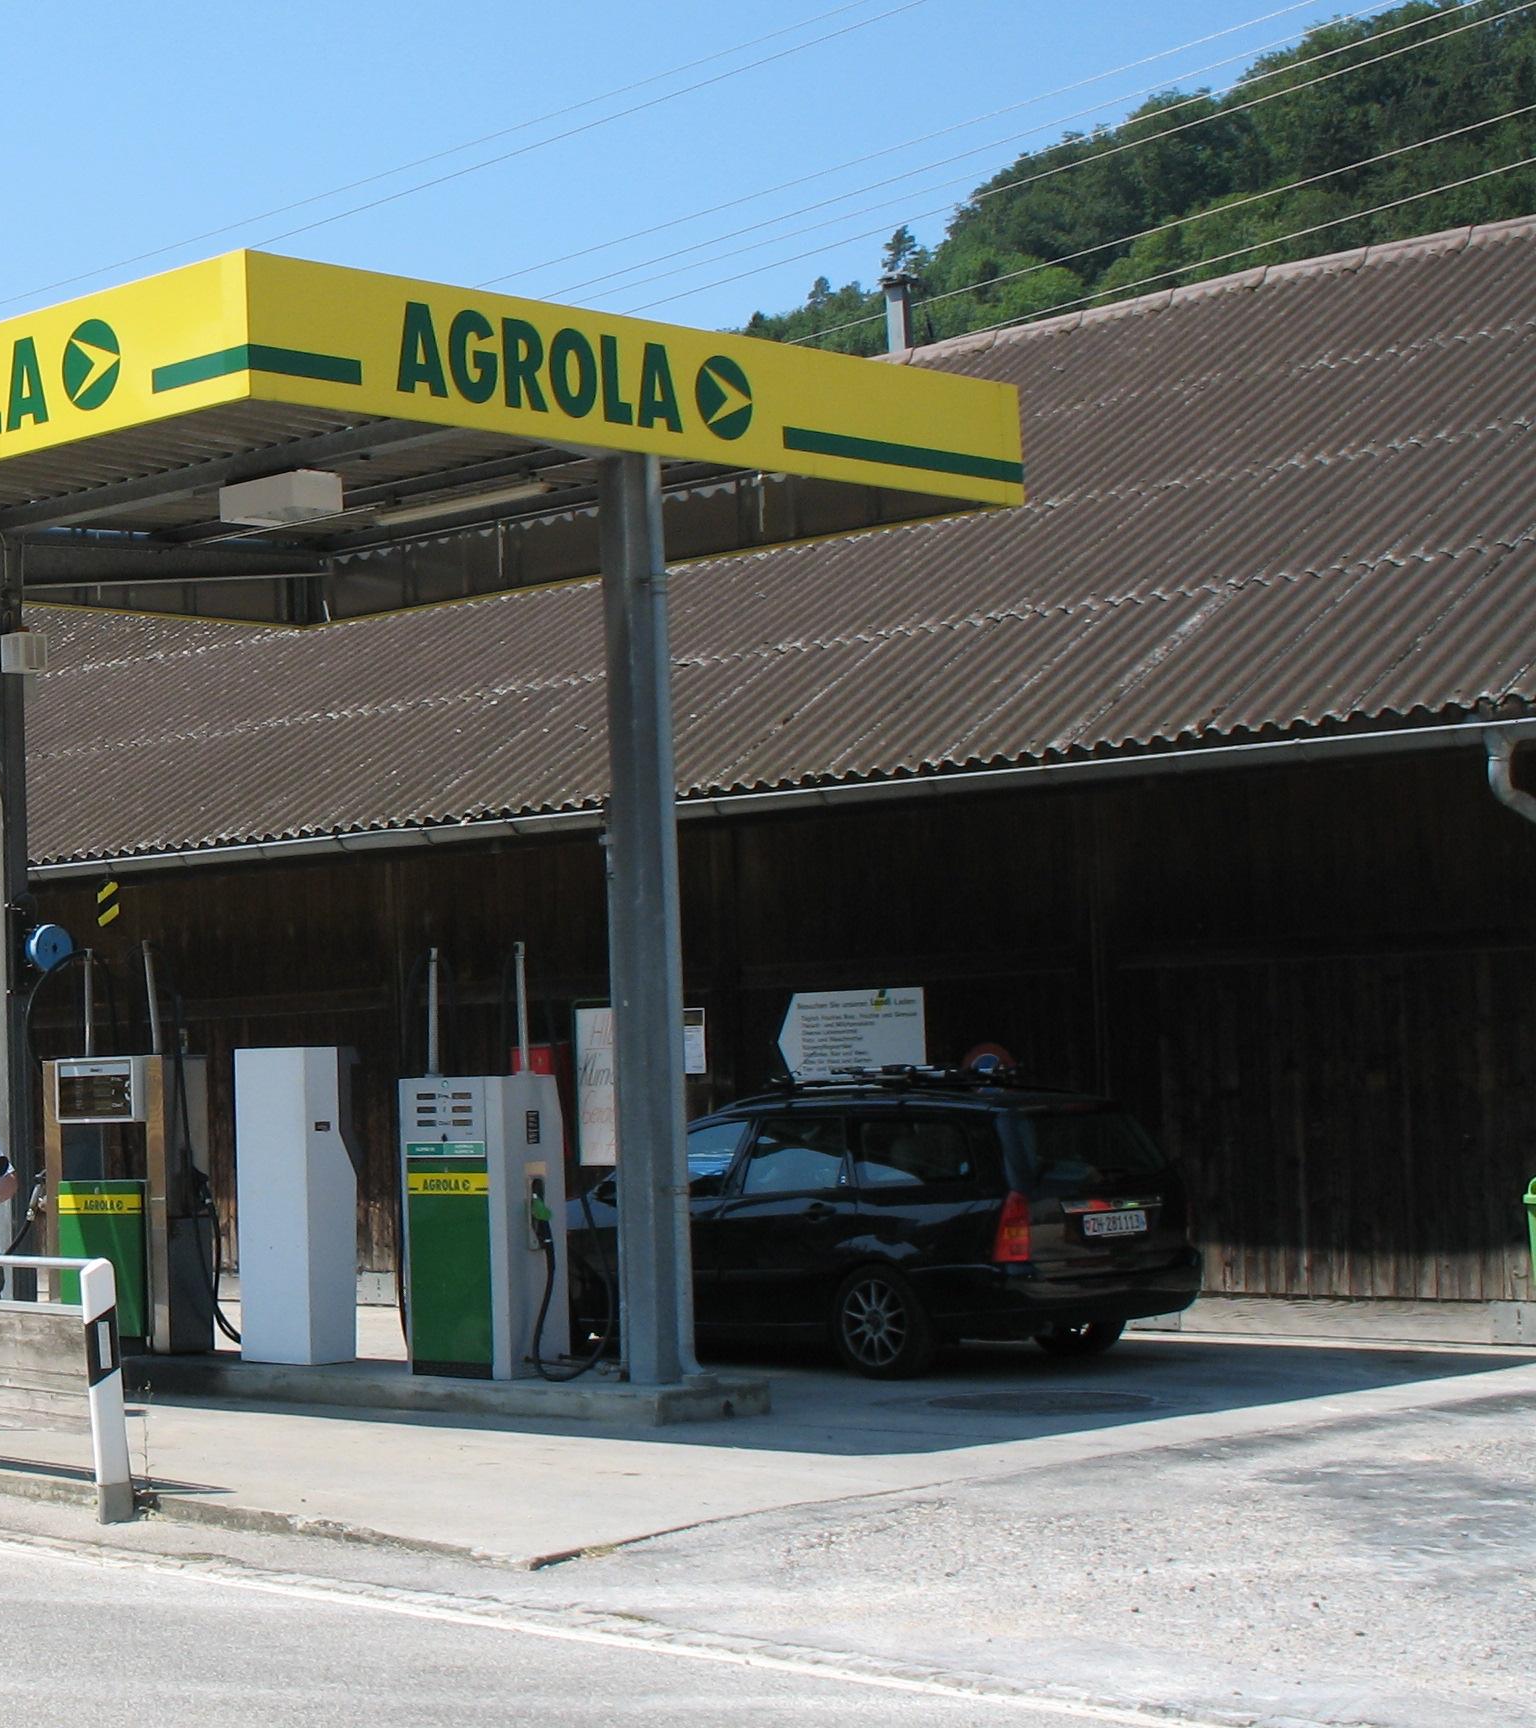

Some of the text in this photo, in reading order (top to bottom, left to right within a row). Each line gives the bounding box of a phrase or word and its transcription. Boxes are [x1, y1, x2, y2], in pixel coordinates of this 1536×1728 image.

[396, 301, 684, 433] AGROLA
[422, 1178, 461, 1192] AGROLA
[83, 1199, 115, 1211] AGROLA
